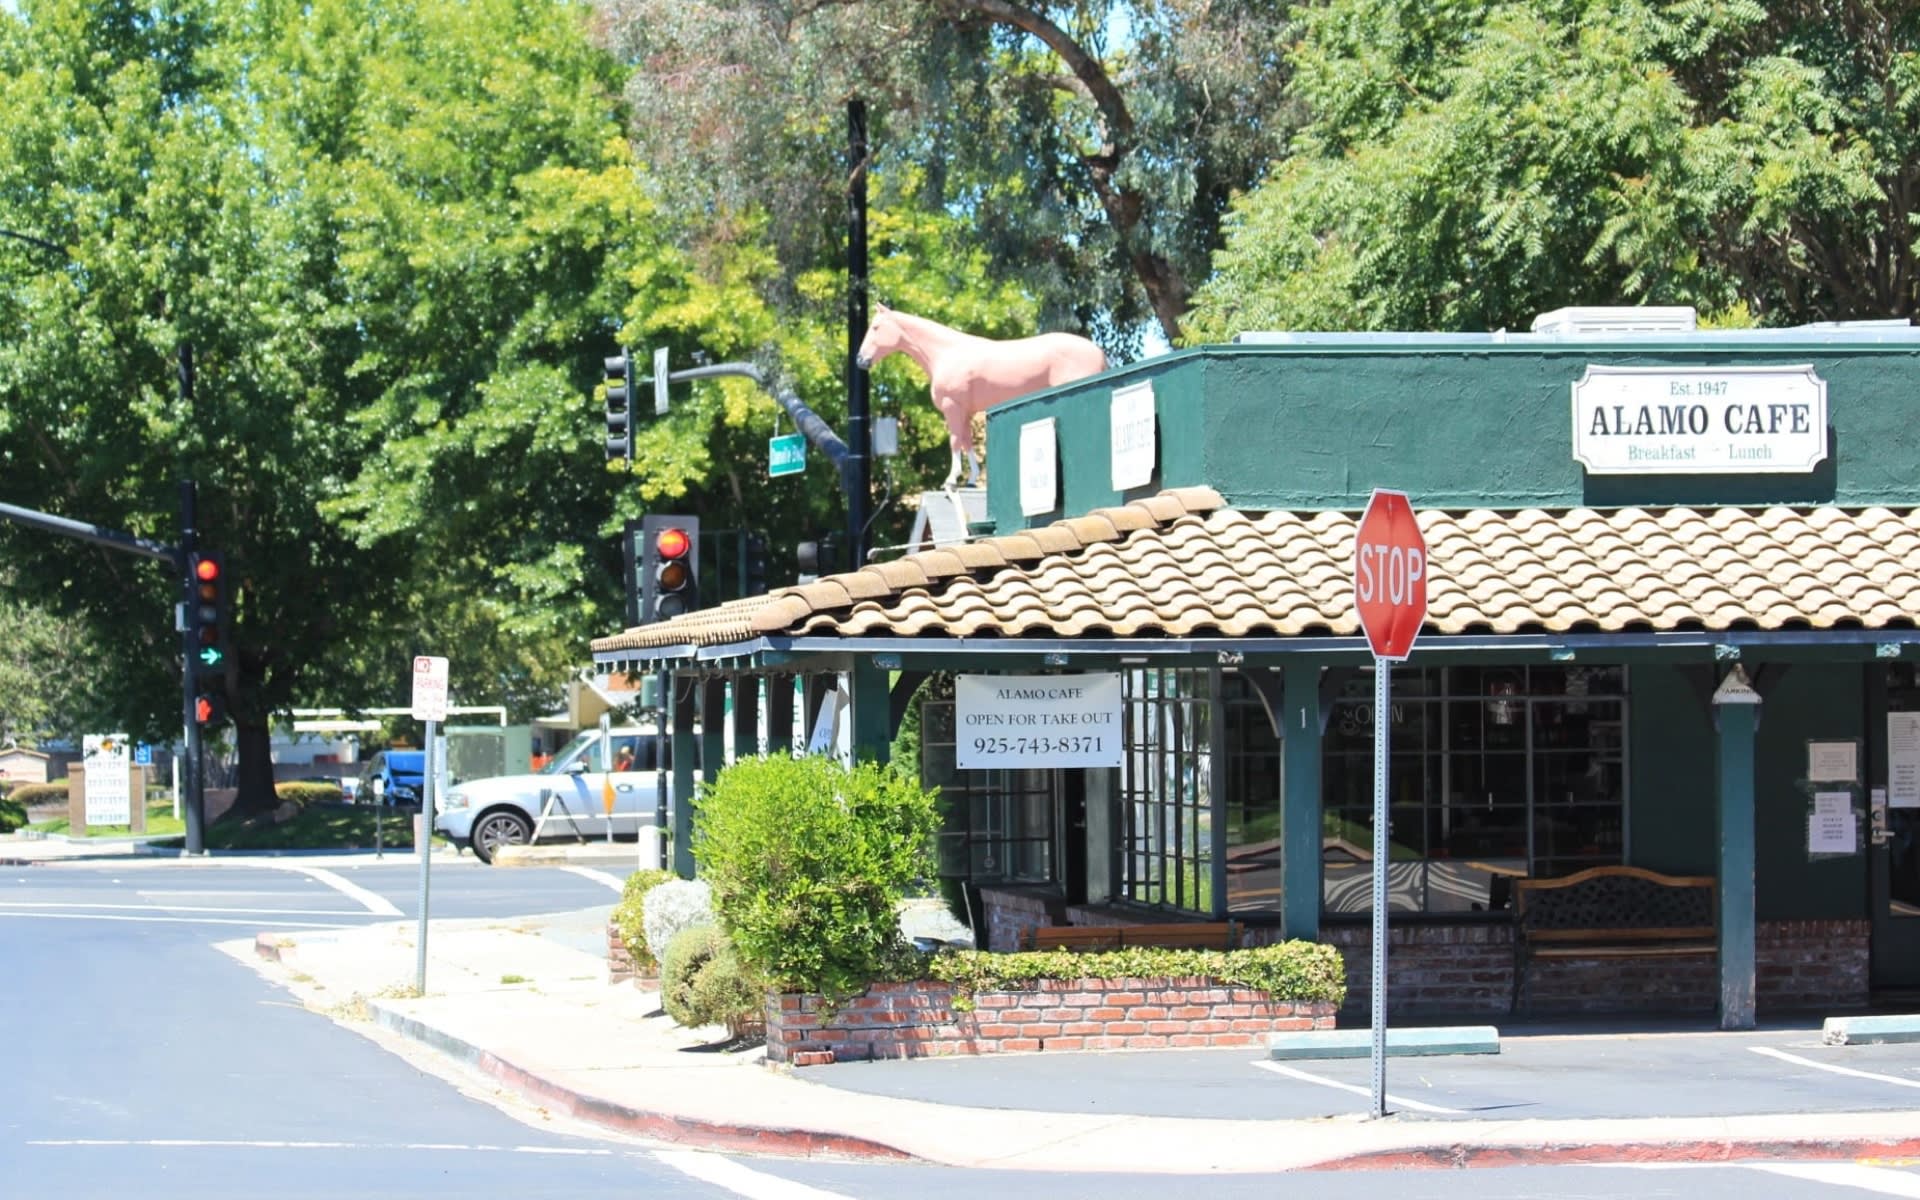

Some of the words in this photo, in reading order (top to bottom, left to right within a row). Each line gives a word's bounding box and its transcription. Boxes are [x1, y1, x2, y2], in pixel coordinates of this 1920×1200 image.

[1670, 381, 1692, 396] Est.
[1697, 381, 1728, 395] 1947
[1589, 404, 1709, 436] ALAMO
[1724, 403, 1811, 434] CAFE
[1628, 444, 1696, 461] Breakfast
[1728, 443, 1772, 460] Lunch
[1359, 543, 1423, 606] STOP
[996, 688, 1045, 700] ALAMO
[1048, 688, 1083, 699] CAFE
[966, 714, 1004, 726] OPEN
[1009, 714, 1036, 725] FOR
[1041, 713, 1078, 725] TAKE
[1081, 712, 1113, 724] OUT
[1355, 704, 1403, 725] ON
[974, 737, 1103, 755] 925-743-8371
